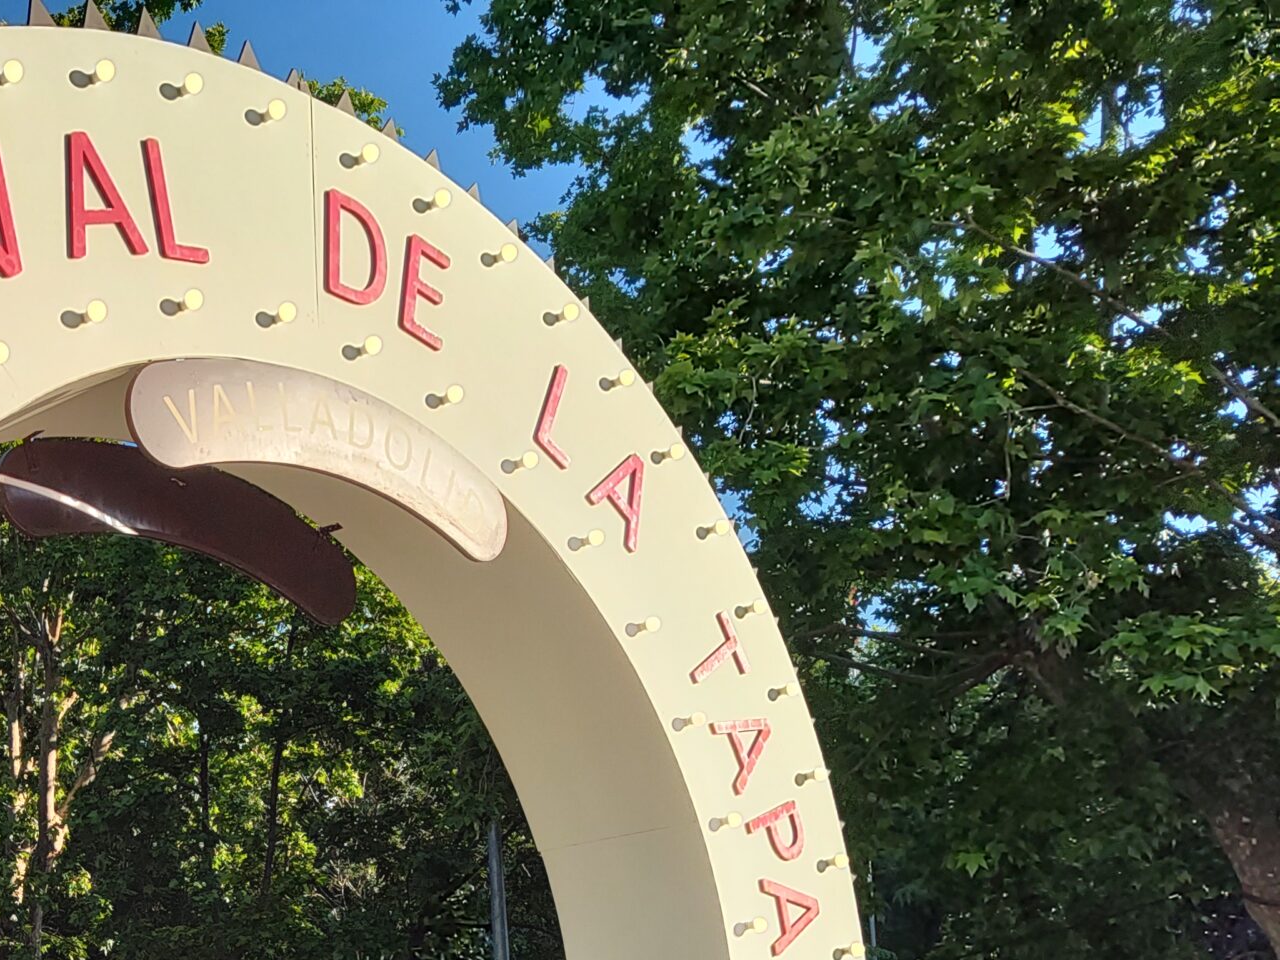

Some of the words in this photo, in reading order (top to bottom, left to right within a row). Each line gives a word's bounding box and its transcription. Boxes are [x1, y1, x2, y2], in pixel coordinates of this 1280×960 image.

[163, 380, 487, 536] VALLADOLID
[322, 187, 452, 352] DE
[533, 363, 646, 555] LA
[690, 609, 822, 959] TAPA
